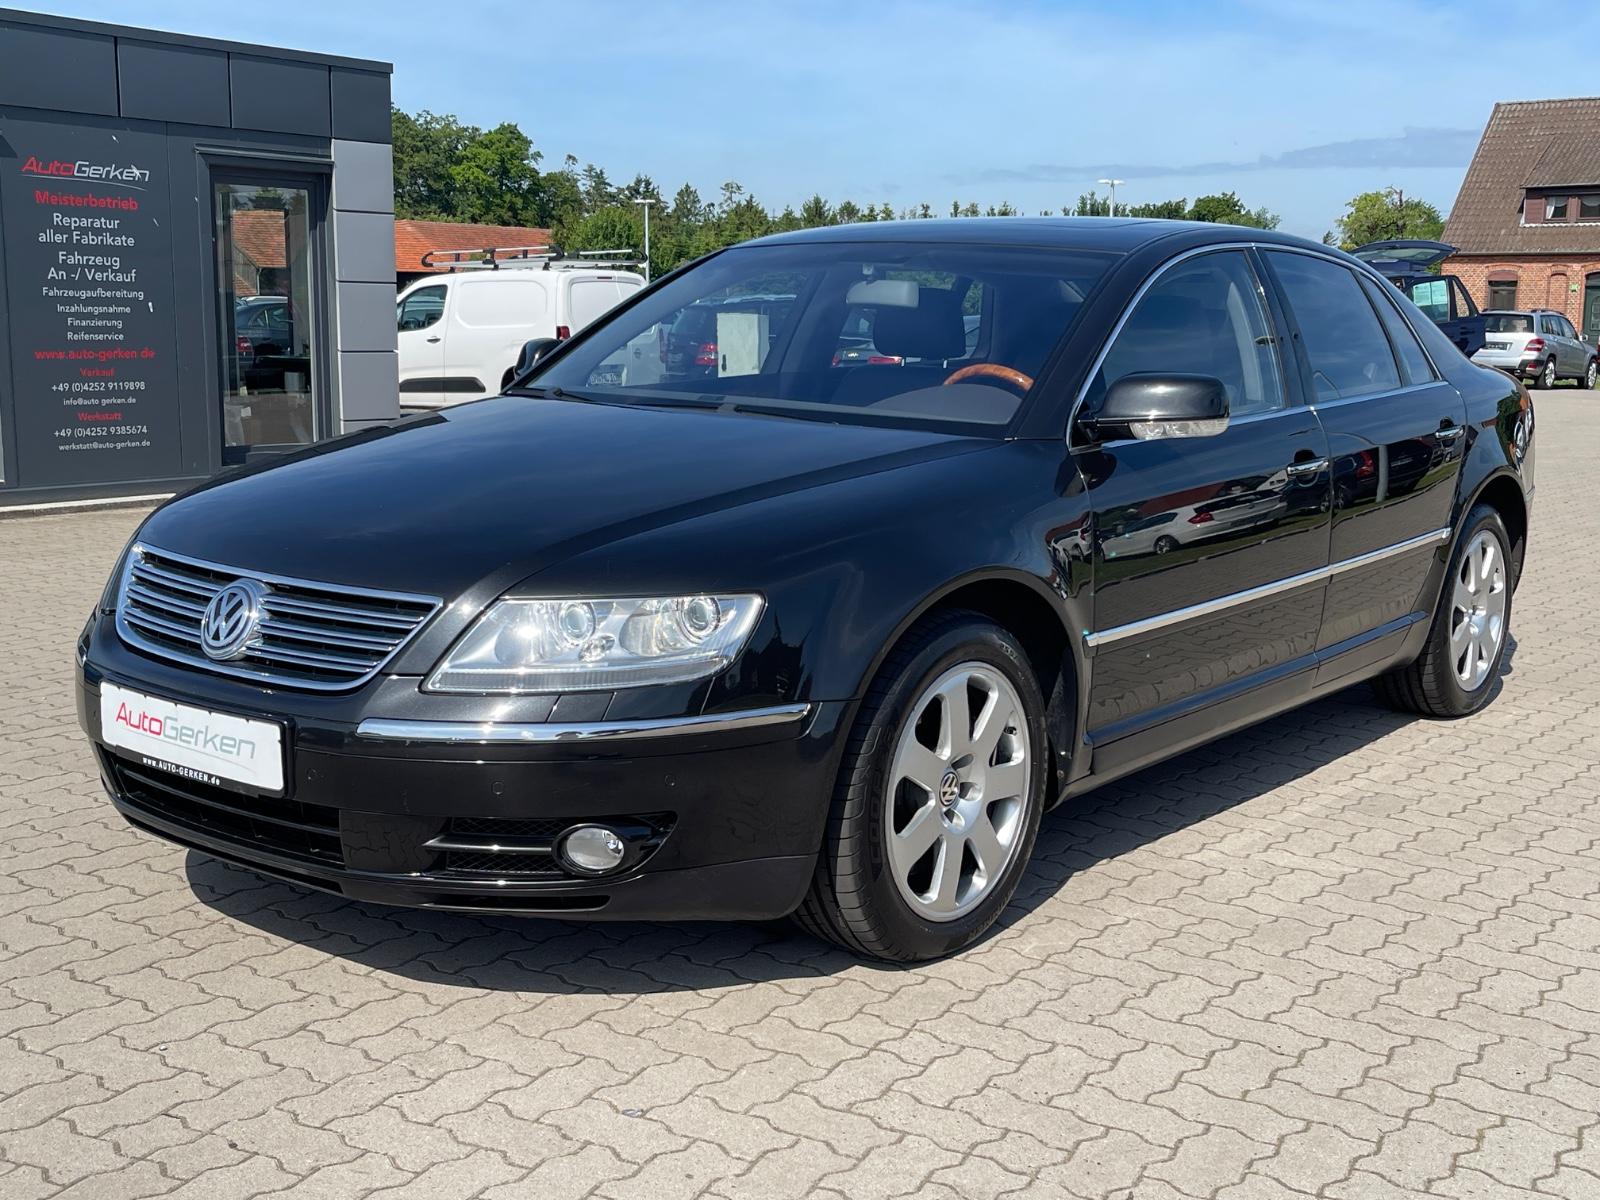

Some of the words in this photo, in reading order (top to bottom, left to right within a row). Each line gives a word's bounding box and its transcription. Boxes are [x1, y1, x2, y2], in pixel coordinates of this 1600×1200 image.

[22, 157, 150, 182] AutoGerken
[35, 190, 139, 210] Meisterbetrieb
[53, 212, 120, 230] Reparatur
[38, 229, 69, 243] aller
[73, 231, 135, 247] Fabrikate
[58, 251, 120, 269] Fahrzeug
[47, 266, 67, 280] An
[84, 268, 136, 282] Verkauf
[42, 287, 144, 300] Fahrzeugaufbereitung
[57, 304, 131, 315] Inzahlungsnahme
[67, 317, 123, 329] Finanzierung
[67, 331, 124, 341] Reifenservice
[34, 347, 155, 361] www.auto-gerkende
[80, 367, 115, 377] Verkauf
[52, 382, 70, 392] +49
[71, 382, 106, 393] (0)4252
[107, 381, 146, 391] 9119898
[63, 396, 137, 407] info@autogerken.de
[78, 412, 123, 421] Werkstatt
[54, 427, 72, 438] +49
[74, 427, 108, 438] (0)4252
[110, 425, 148, 435] 9385674
[58, 439, 151, 451] werkstatt@auto-gerken.de
[115, 702, 256, 760] AutoGerken
[142, 757, 220, 786] www.AUTO-GERKEN.de
